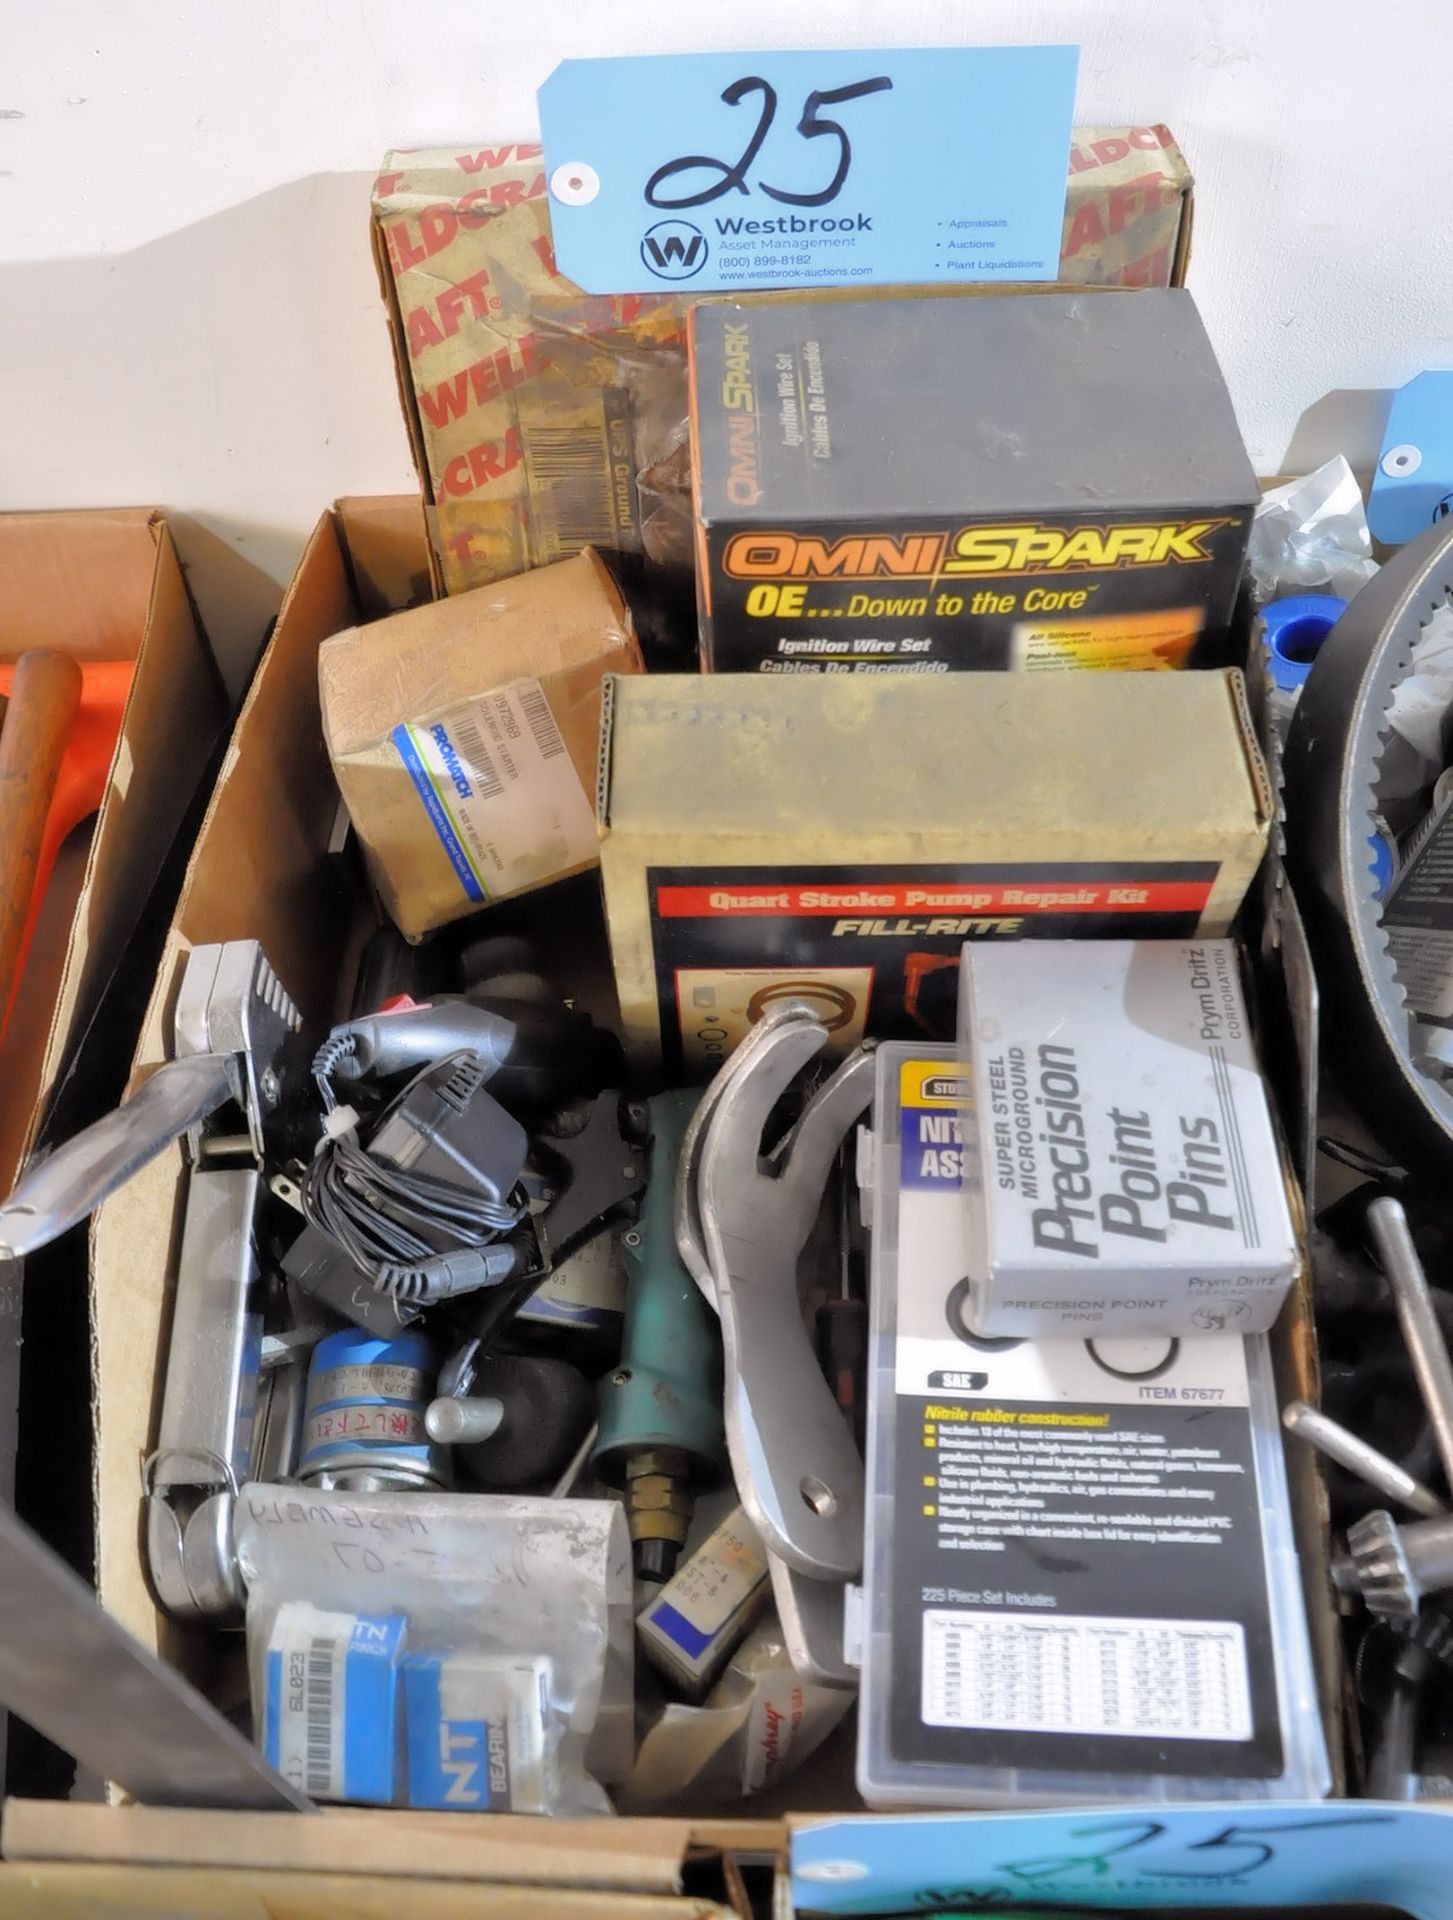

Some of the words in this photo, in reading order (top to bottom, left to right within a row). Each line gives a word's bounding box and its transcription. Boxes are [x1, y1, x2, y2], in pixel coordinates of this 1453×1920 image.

[644, 75, 893, 210] 25
[714, 213, 873, 236] Westbrook
[949, 217, 1008, 230] Appraisals
[718, 239, 757, 251] Asset
[761, 236, 856, 251] Management
[948, 238, 996, 251] Auctions
[719, 255, 751, 269] (800)
[754, 254, 812, 268] 899-8182
[947, 259, 975, 271] Plant
[978, 258, 1045, 272] Liquidations
[719, 265, 873, 281] www.westbrook-auctions.com
[935, 594, 962, 616] to
[971, 592, 1016, 615] the
[1022, 588, 1088, 613] Core
[777, 637, 850, 655] Ignition
[852, 638, 896, 653] Wire
[900, 638, 933, 653] Set
[760, 660, 820, 674] Cables
[825, 661, 849, 674] De
[852, 661, 949, 674] Encendido
[429, 722, 474, 801] PROMATCH
[709, 891, 790, 910] Quart
[799, 891, 896, 908] Stroke
[903, 890, 993, 909] Pump
[1001, 888, 1100, 907] Repair
[1106, 887, 1151, 905] Kit
[831, 917, 1025, 937] FILL-RITE
[1213, 948, 1242, 1040] CORPORATION
[1200, 994, 1223, 1041] Prym
[988, 1055, 1009, 1116] STEEL
[1009, 1047, 1039, 1200] MICROGROUND
[995, 1121, 1016, 1191] SUPER
[1031, 1044, 1100, 1260] Precision
[1099, 1106, 1168, 1243] Point
[1165, 1115, 1235, 1231] Pins
[1002, 1300, 1106, 1311] PRECISION
[1110, 1299, 1169, 1310] POINT
[1060, 1312, 1104, 1322] PINS
[942, 1372, 972, 1388] SAE
[1138, 1386, 1178, 1400] ITEM
[924, 1404, 969, 1421] Nitrile
[971, 1407, 1016, 1424] rubber
[921, 1587, 945, 1602] 225
[947, 1588, 981, 1604] Piece
[982, 1590, 1004, 1605] Set
[1005, 1592, 1058, 1607] Includes
[995, 1816, 1396, 1880] 25
